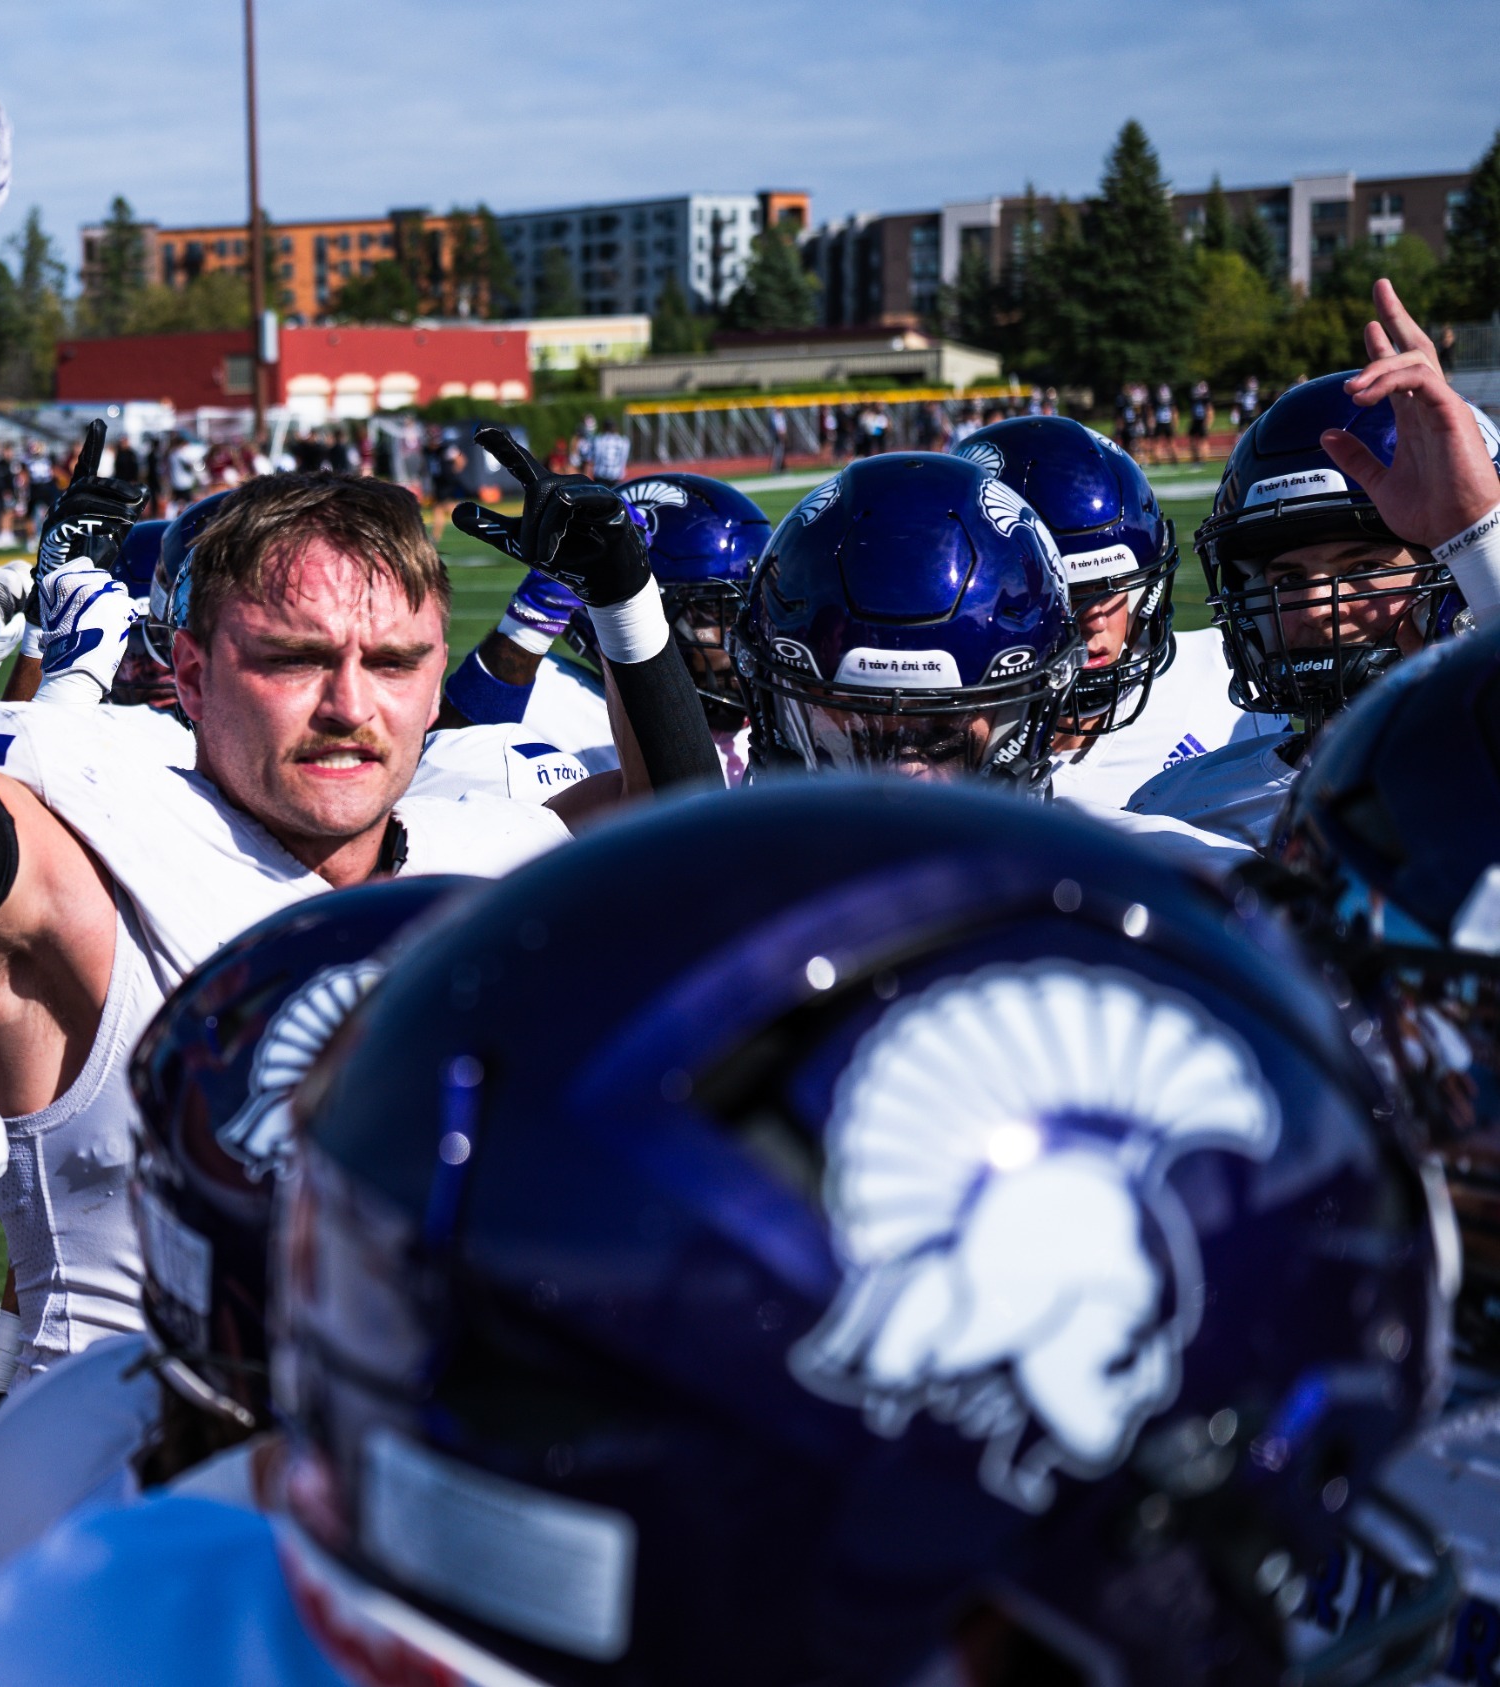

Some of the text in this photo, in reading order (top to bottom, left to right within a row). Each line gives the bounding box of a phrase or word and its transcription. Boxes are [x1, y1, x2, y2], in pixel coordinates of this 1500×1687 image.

[1437, 511, 1500, 560] I AM SECON
[991, 661, 1034, 678] OAKLEY
[1281, 658, 1334, 675] ddell
